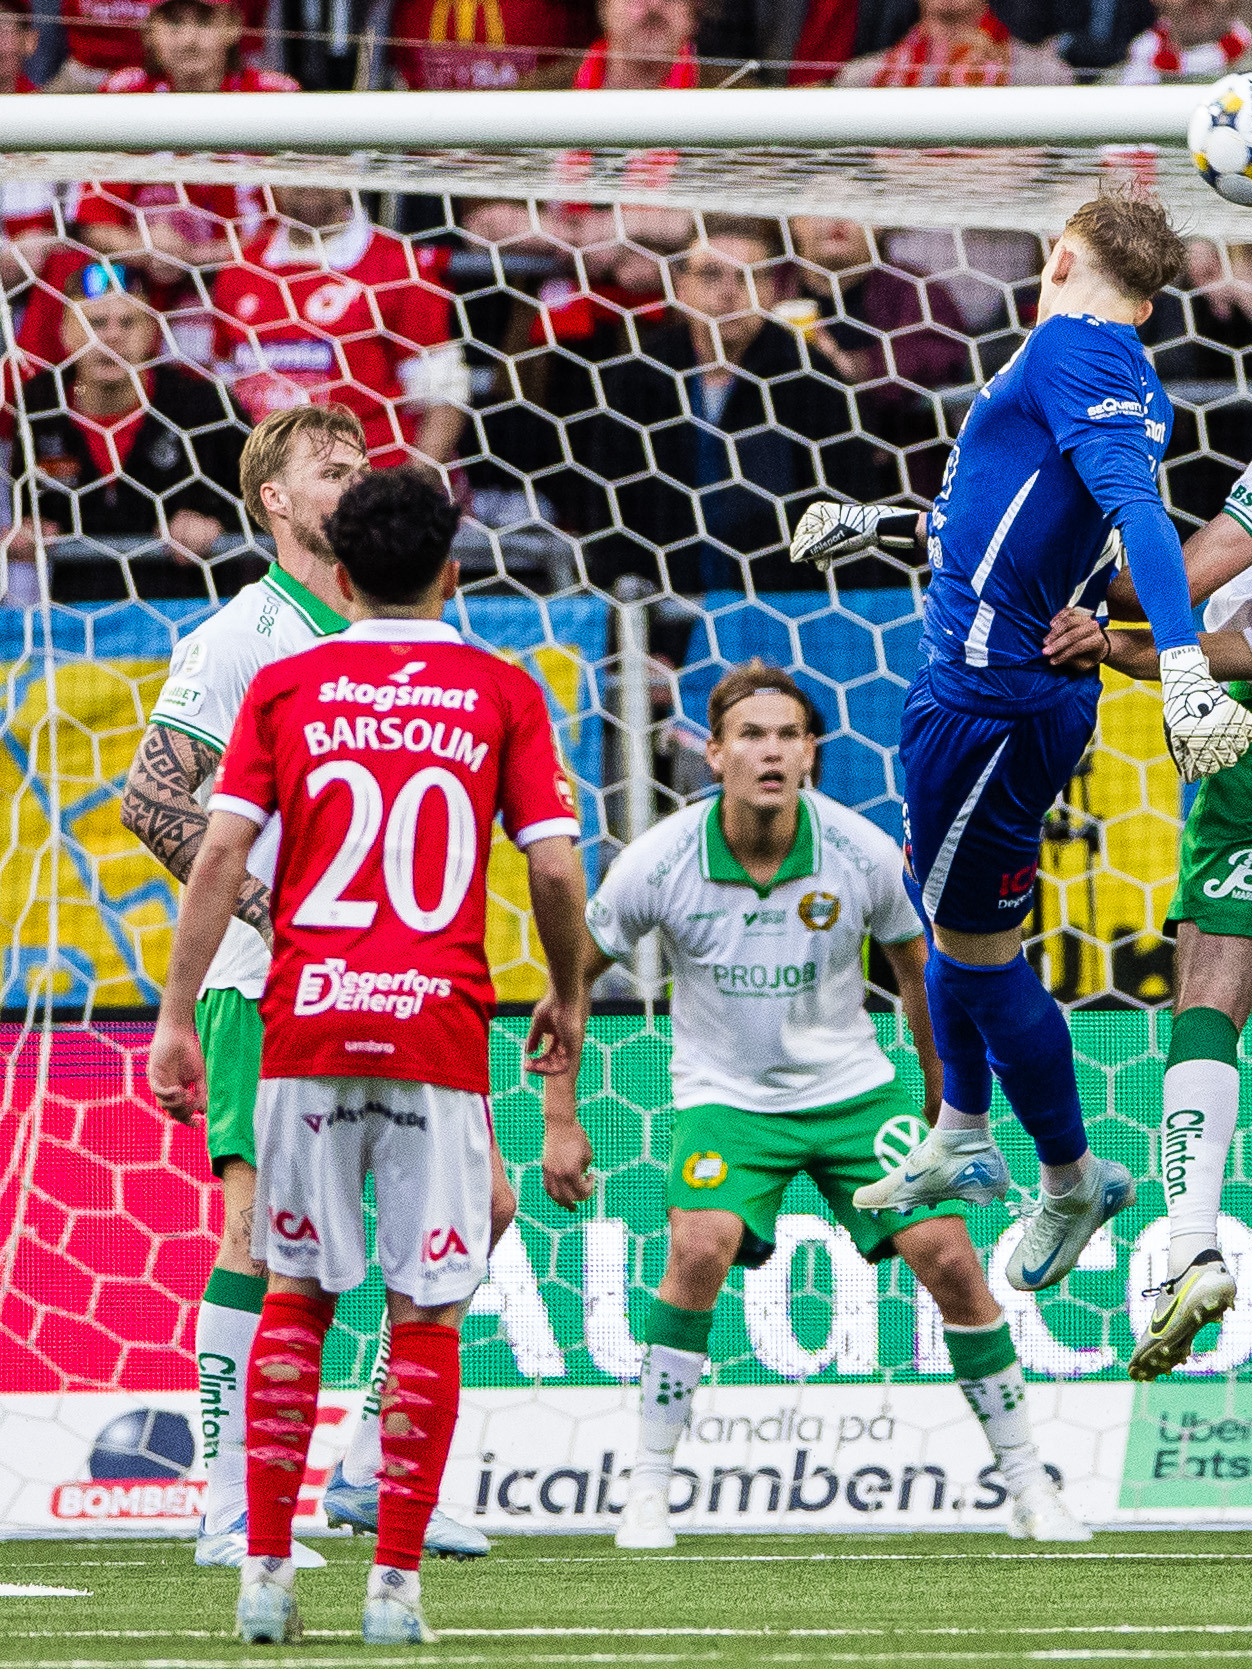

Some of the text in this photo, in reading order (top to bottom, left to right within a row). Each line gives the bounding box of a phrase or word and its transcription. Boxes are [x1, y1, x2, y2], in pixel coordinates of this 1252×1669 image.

[318, 675, 479, 713] skogsmat
[303, 716, 490, 773] BARSOUM
[292, 759, 477, 933] 20
[714, 960, 817, 988] PROJOB
[335, 991, 425, 1020] Energi
[1166, 1109, 1205, 1199] Clinton
[198, 1352, 237, 1459] Clinton
[835, 1404, 895, 1447] på
[1154, 1449, 1252, 1480] Eats
[57, 1484, 207, 1515] BOMBEN
